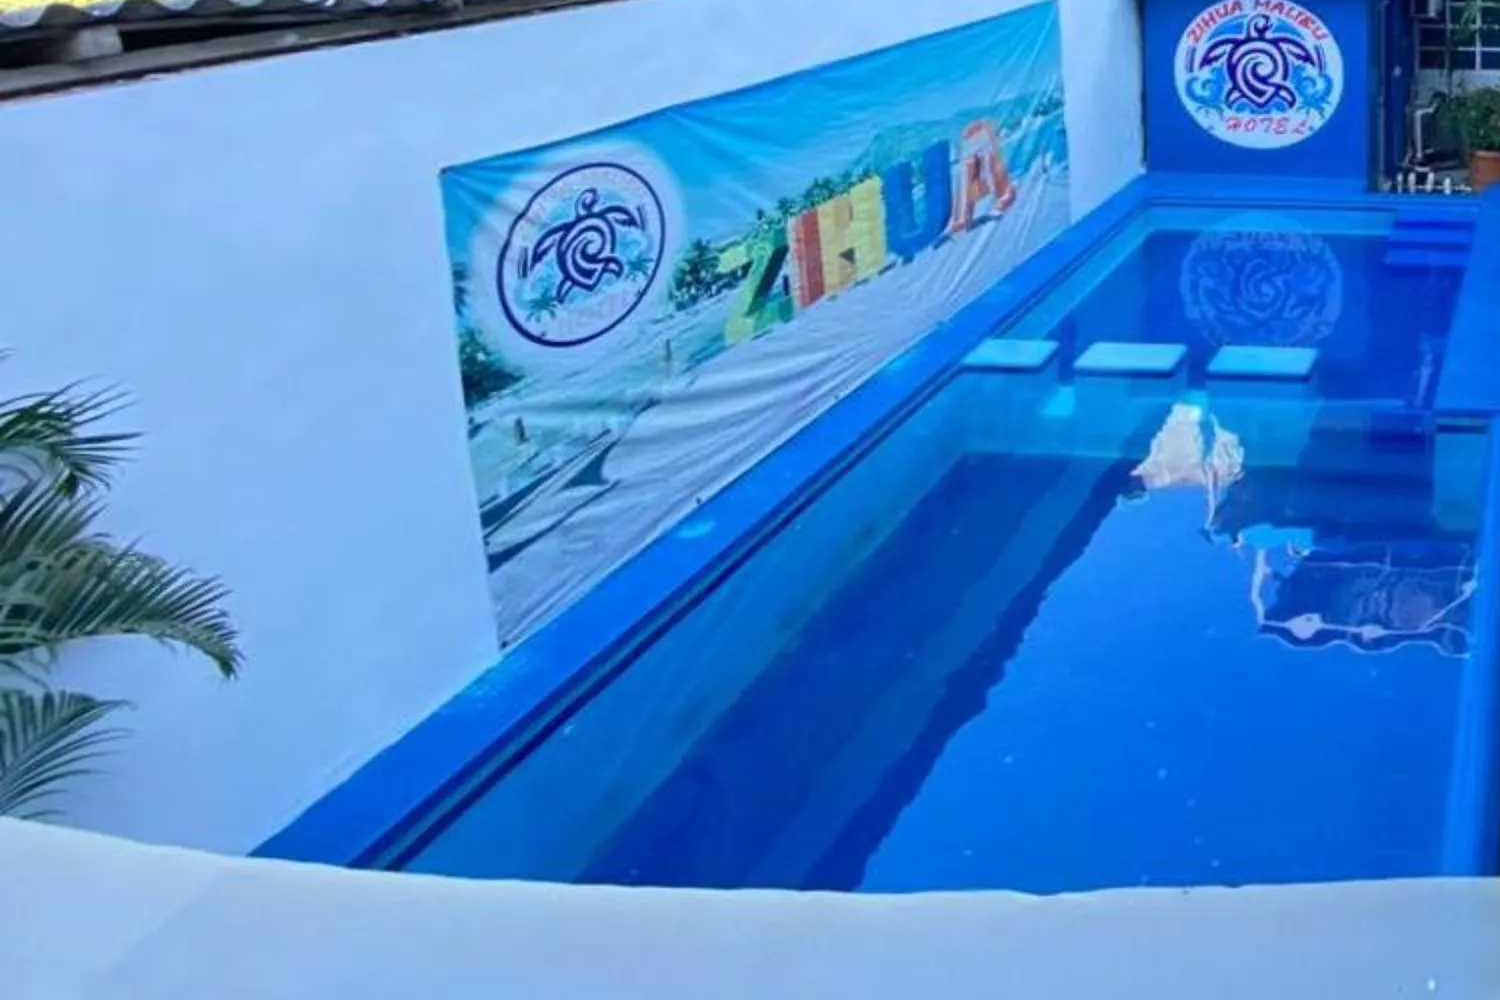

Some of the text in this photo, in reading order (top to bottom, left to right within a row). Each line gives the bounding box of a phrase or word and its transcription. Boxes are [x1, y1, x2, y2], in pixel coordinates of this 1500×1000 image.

[1187, 0, 1243, 44] ZIHUA
[1225, 114, 1312, 135] HOTEL
[718, 118, 1017, 346] ZIHUA
